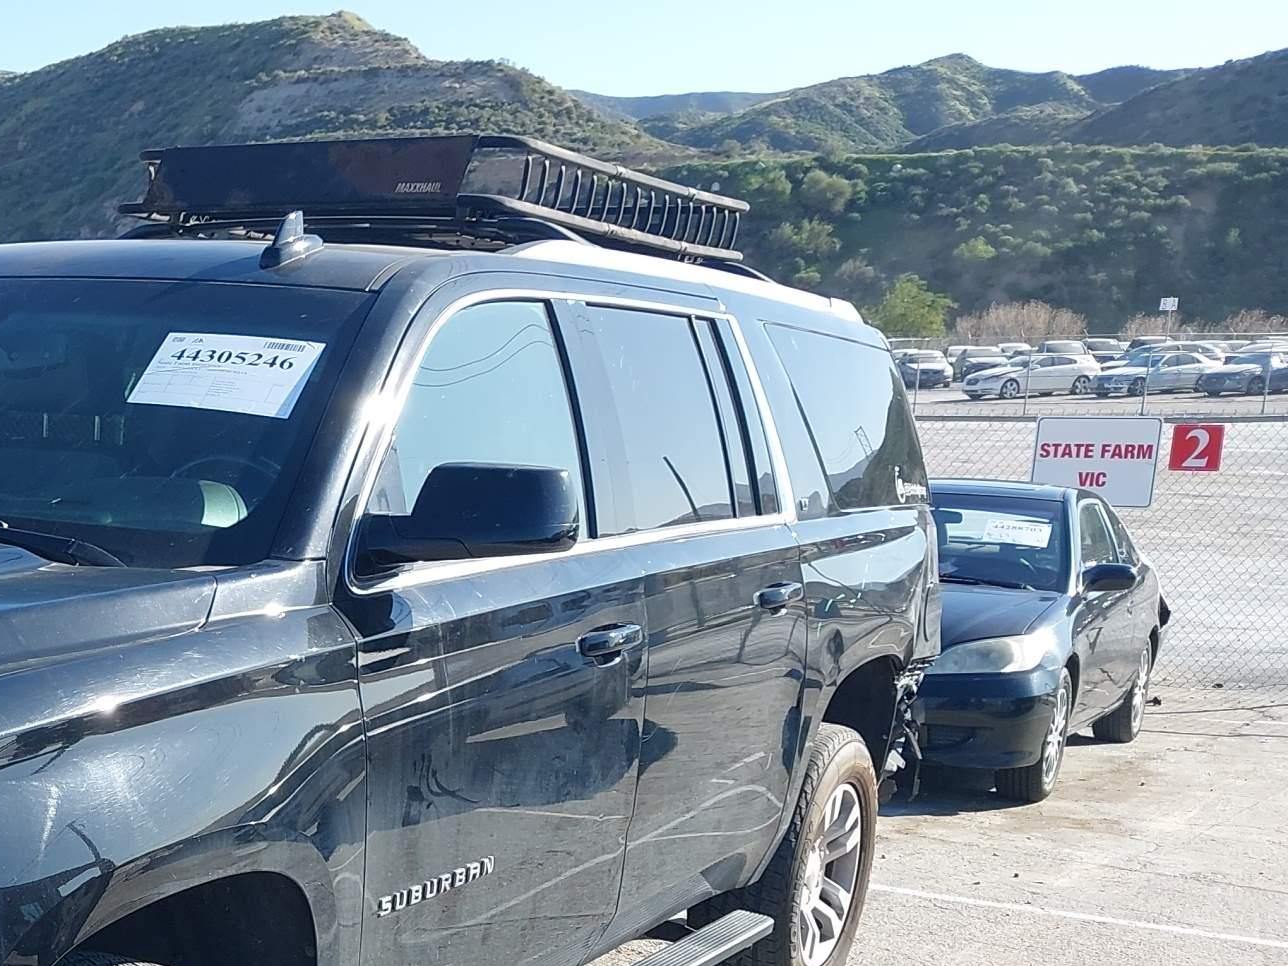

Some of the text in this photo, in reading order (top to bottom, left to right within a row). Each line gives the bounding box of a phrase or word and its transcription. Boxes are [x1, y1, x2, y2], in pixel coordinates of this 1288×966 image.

[394, 182, 441, 193] MAXXHAUL
[170, 347, 297, 371] 44305246
[1039, 442, 1154, 460] STATE FARM
[1181, 428, 1210, 468] 2
[1078, 471, 1107, 487] VIC
[377, 855, 495, 918] SUBURBAN
